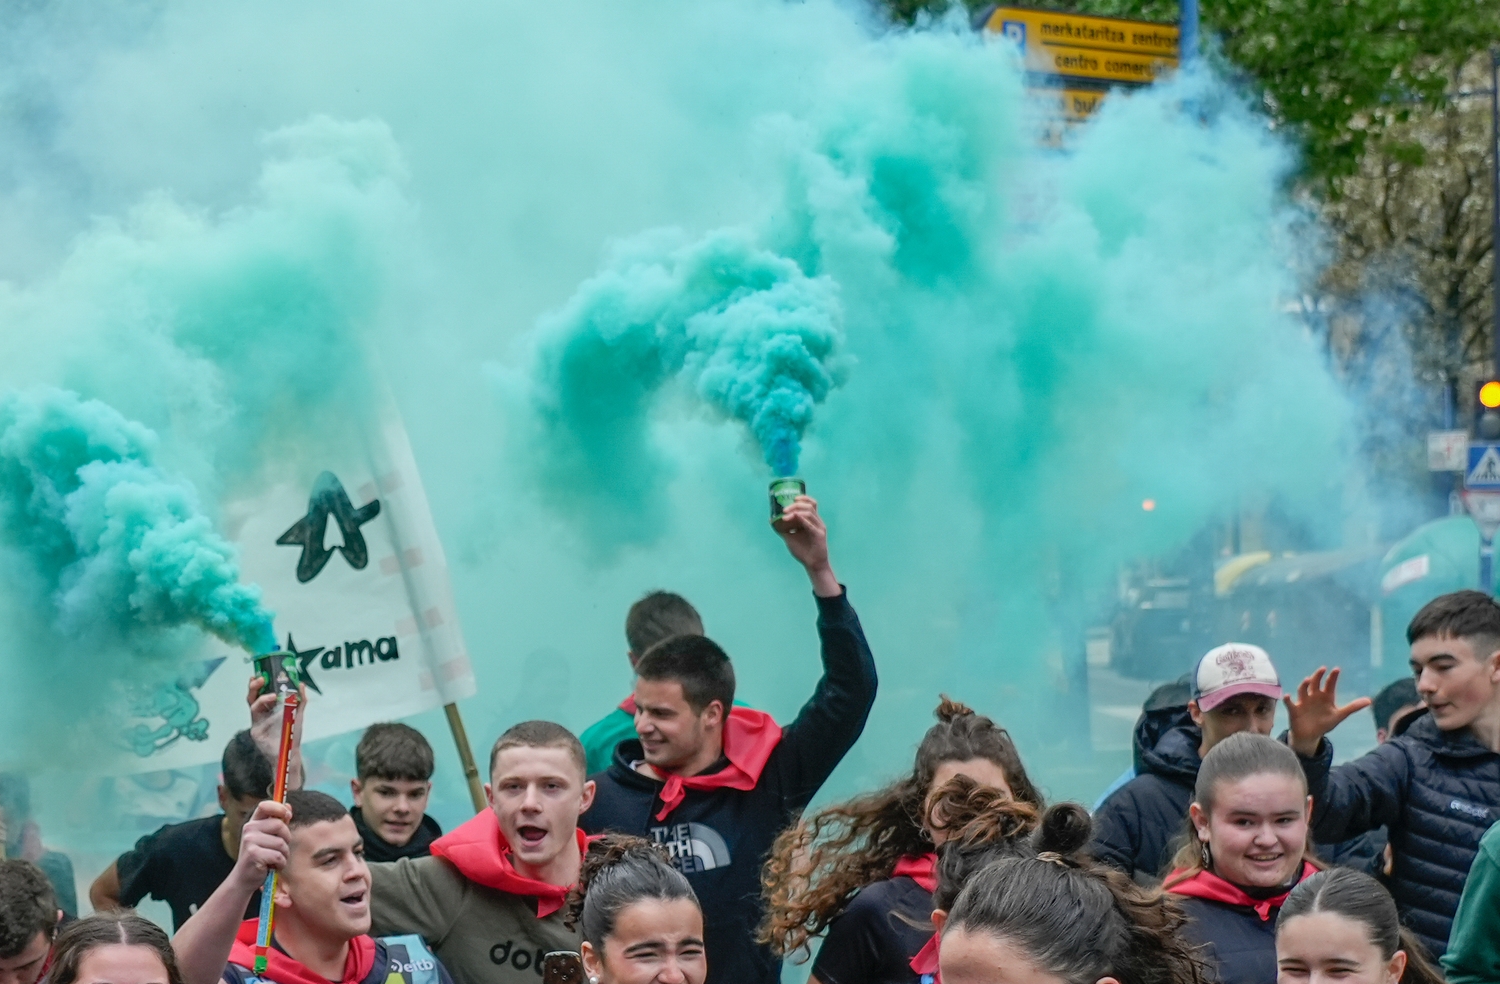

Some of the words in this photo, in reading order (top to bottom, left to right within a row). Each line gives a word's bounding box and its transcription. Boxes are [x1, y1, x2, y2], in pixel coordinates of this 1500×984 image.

[1041, 22, 1125, 43] merkataritza
[1055, 53, 1098, 71] centro
[403, 960, 434, 973] eitb
